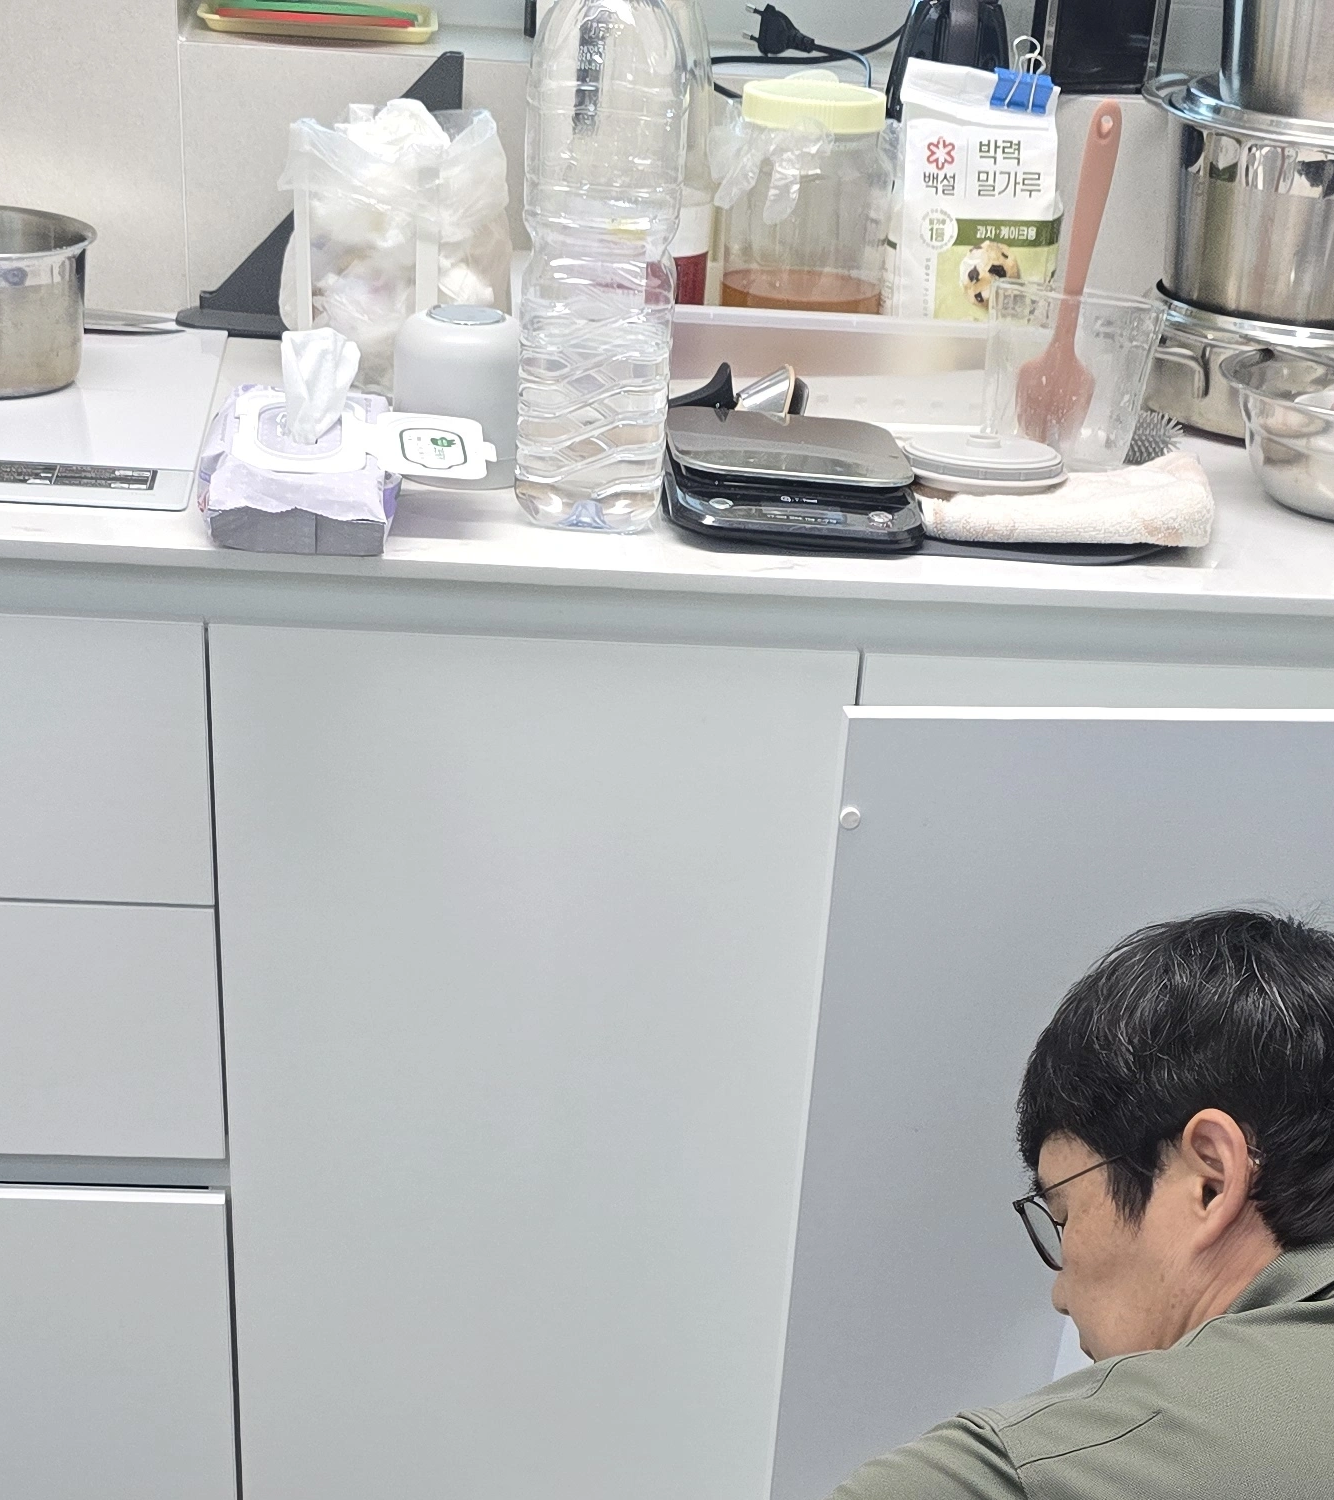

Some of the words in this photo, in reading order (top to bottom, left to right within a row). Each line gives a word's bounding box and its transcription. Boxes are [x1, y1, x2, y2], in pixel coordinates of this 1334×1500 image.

[979, 139, 1021, 166] 박력
[923, 171, 956, 197] 백설
[977, 170, 1042, 198] 밀가루
